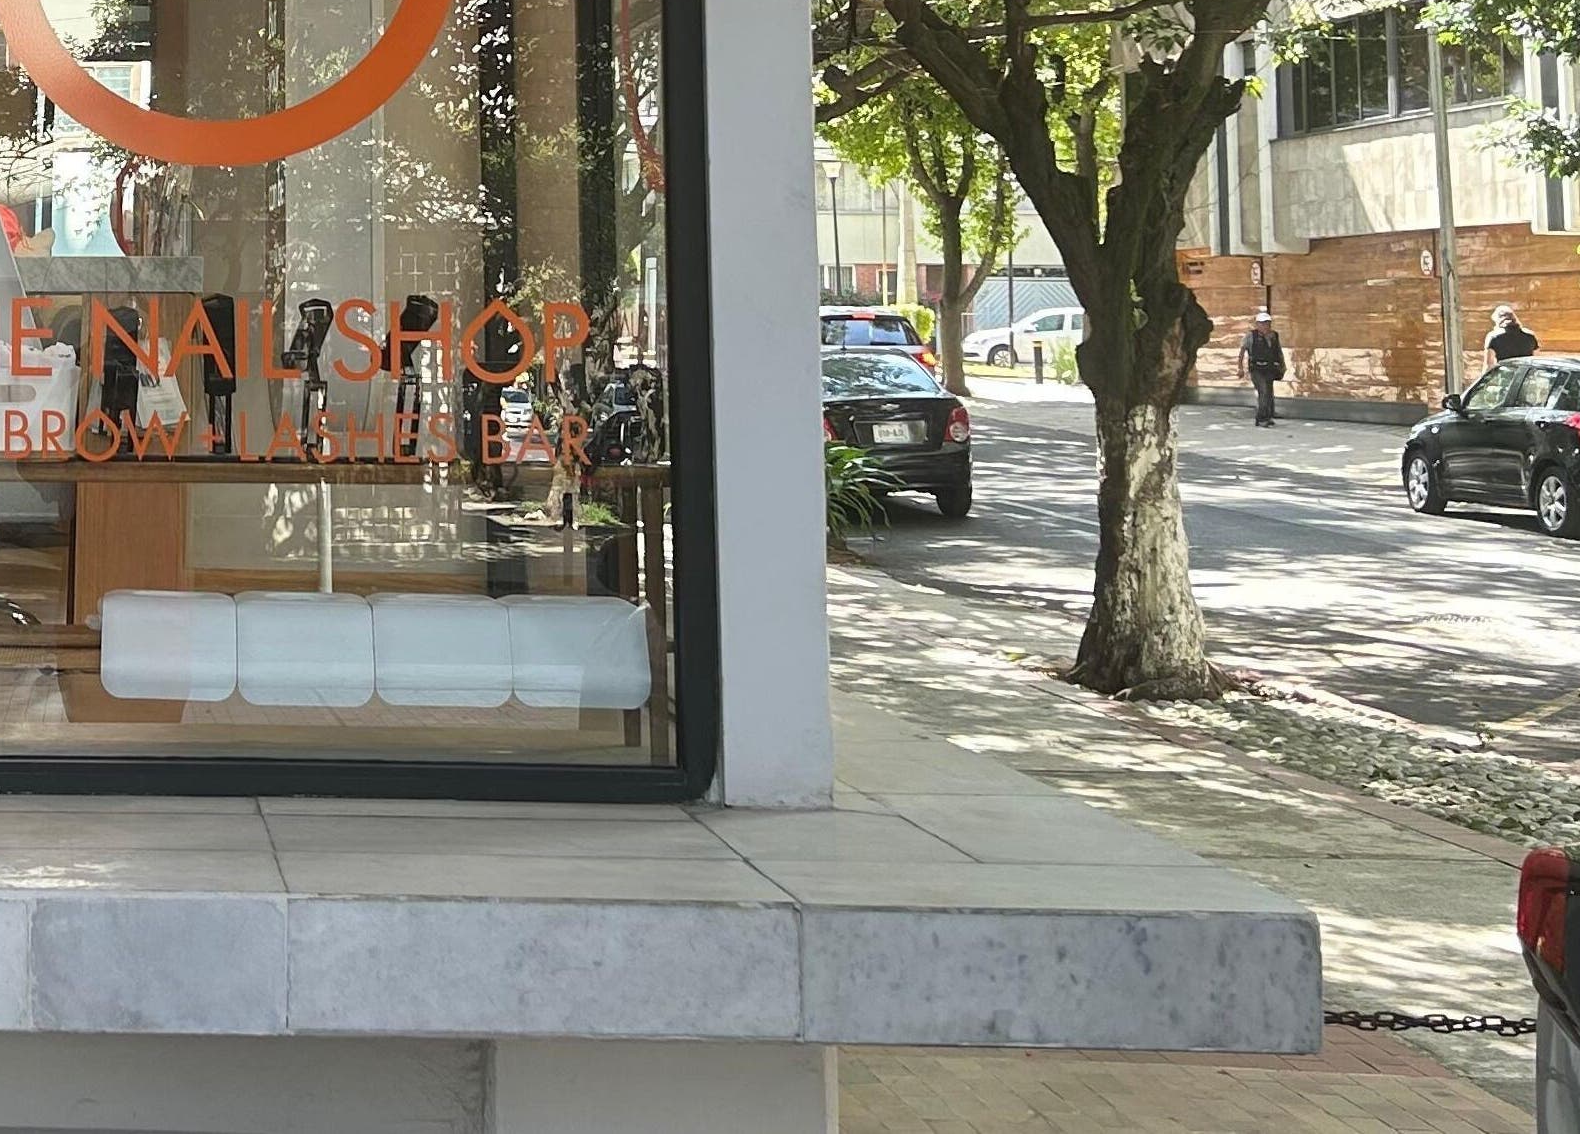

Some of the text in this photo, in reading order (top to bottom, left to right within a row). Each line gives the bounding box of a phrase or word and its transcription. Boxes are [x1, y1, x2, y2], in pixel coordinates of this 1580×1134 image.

[91, 297, 301, 380] NAIL
[334, 297, 591, 383] SHOP
[4, 409, 187, 462] BROW
[240, 411, 457, 464] LASHES
[481, 413, 593, 466] BAR
